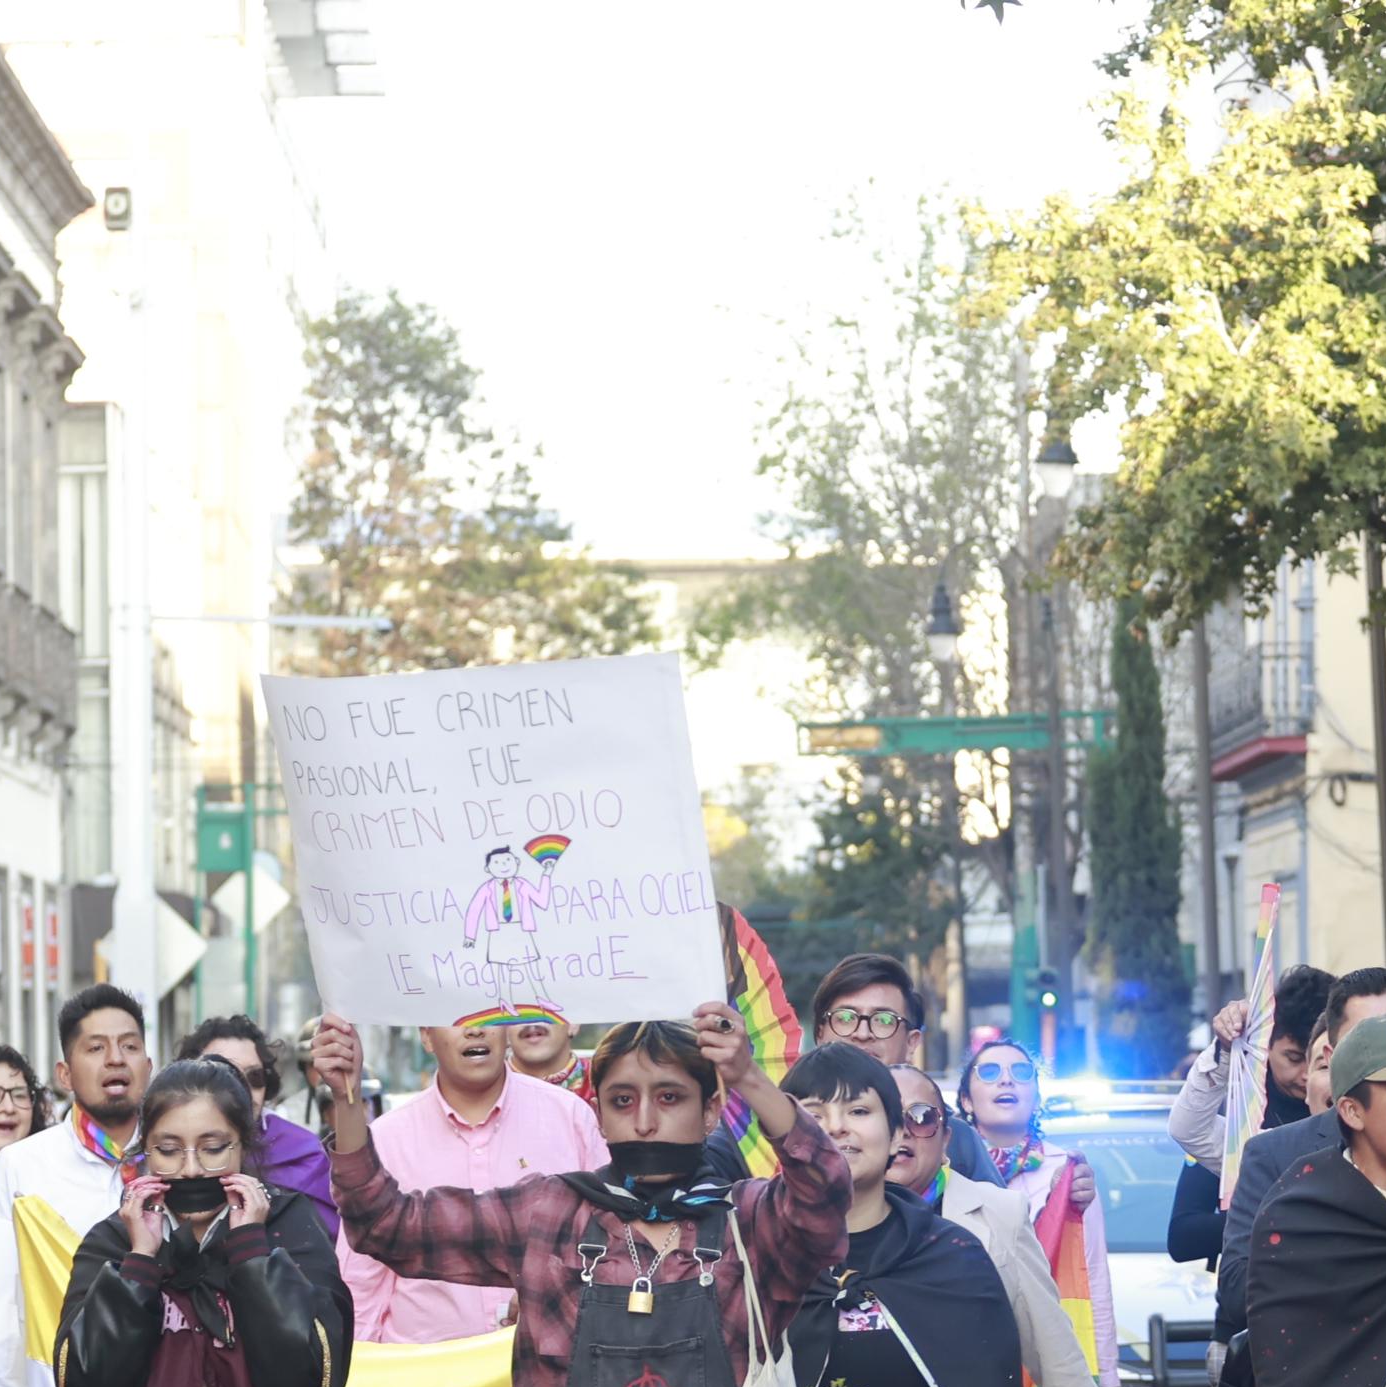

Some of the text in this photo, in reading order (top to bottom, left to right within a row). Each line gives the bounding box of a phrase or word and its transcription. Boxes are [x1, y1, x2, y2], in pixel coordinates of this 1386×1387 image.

[282, 688, 574, 742] NO FUE CRIMEN
[292, 743, 533, 798] PASIONAL, FUE
[312, 789, 623, 854] CRIMEN DE ODIO
[311, 870, 717, 928] JUSTICIA PARA OCIEL
